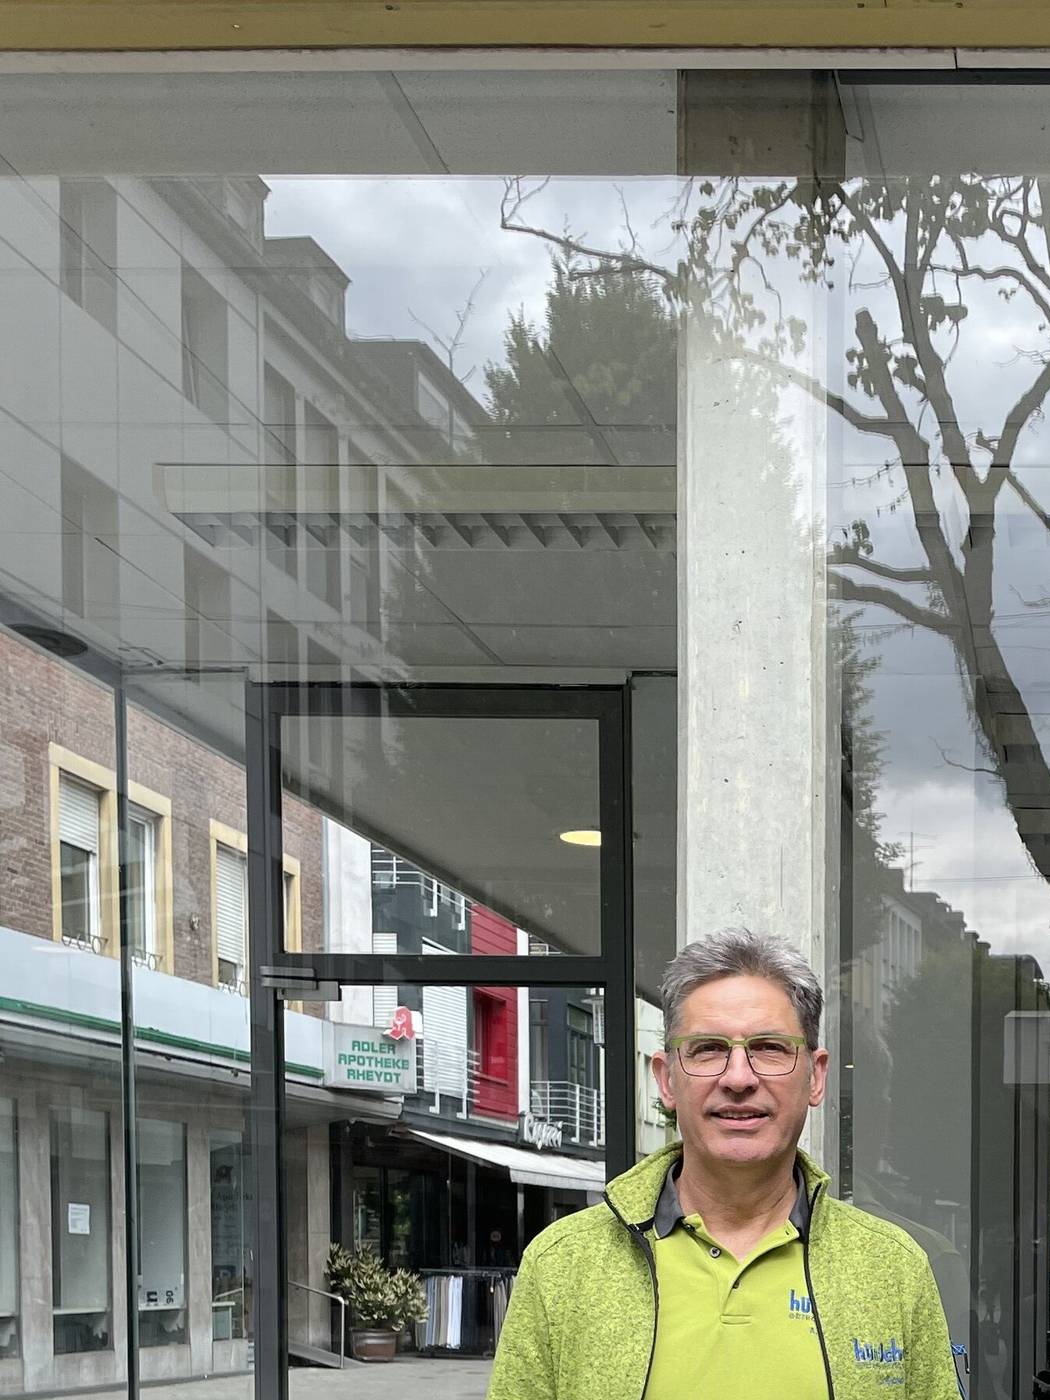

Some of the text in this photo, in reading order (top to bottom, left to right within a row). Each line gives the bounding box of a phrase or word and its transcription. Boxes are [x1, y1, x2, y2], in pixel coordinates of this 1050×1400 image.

[352, 1040, 396, 1055] ADLER
[338, 1053, 409, 1070] APOTHEKE
[347, 1068, 401, 1083] RHEYDT
